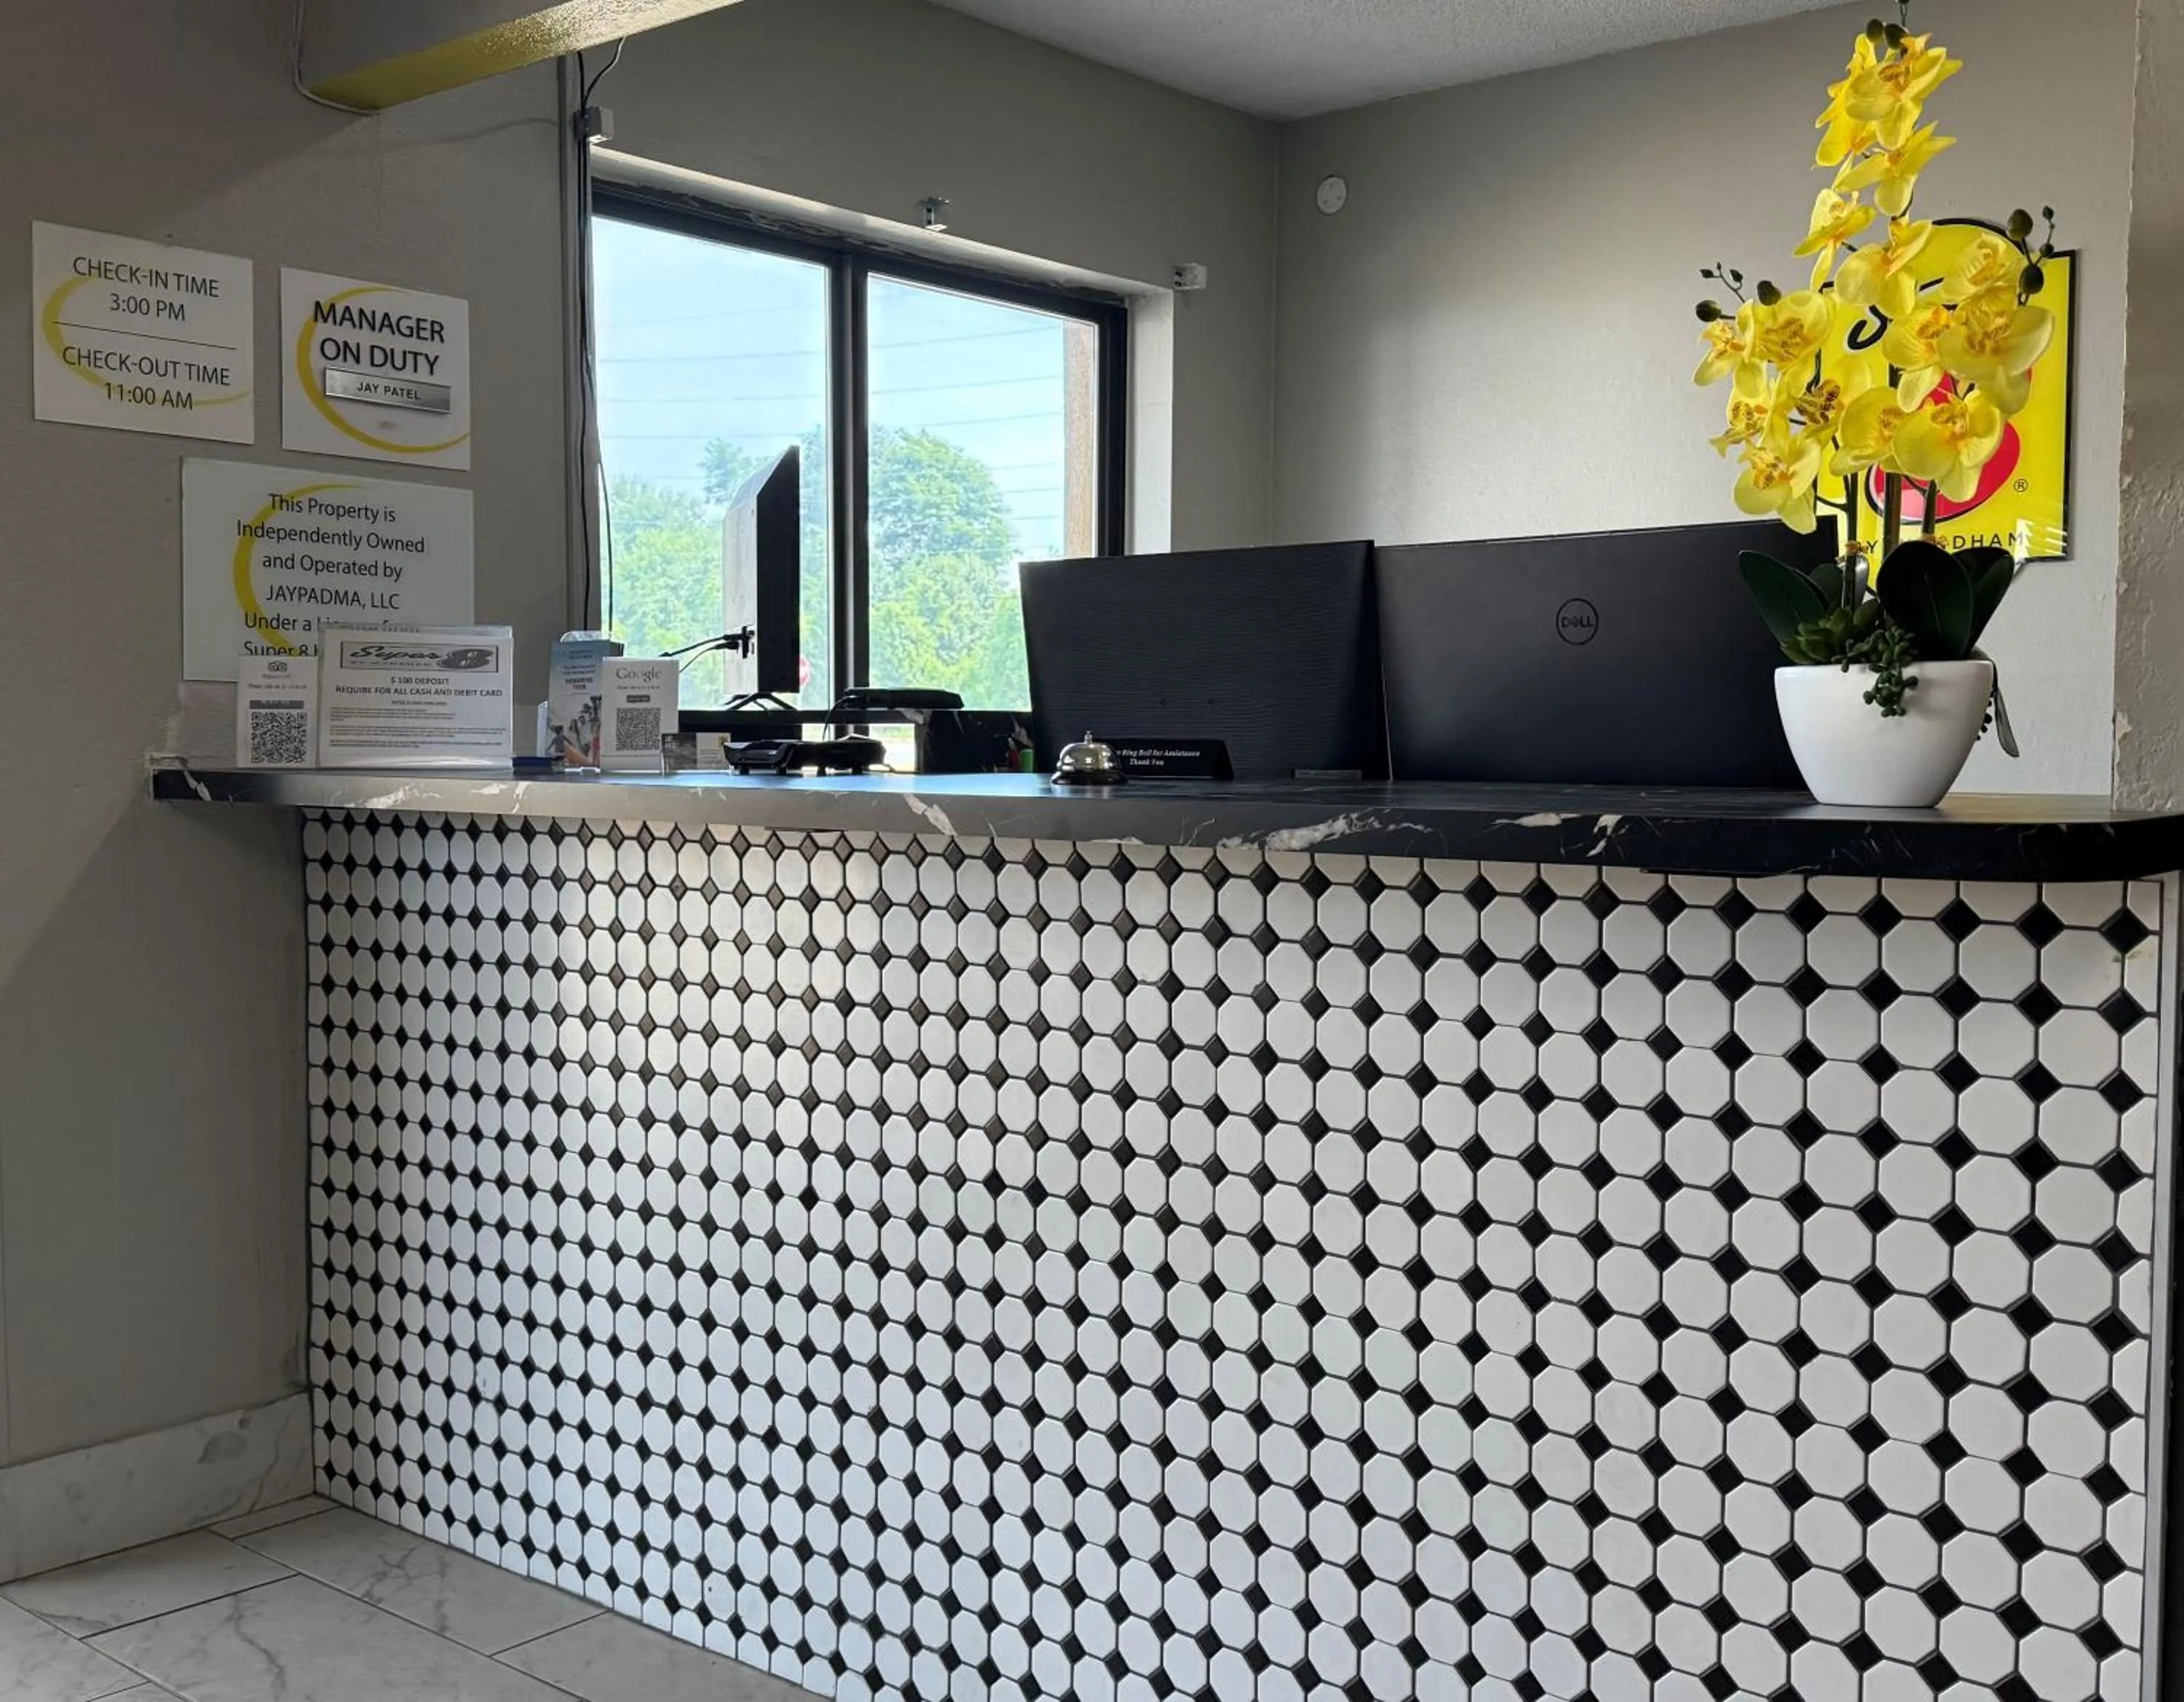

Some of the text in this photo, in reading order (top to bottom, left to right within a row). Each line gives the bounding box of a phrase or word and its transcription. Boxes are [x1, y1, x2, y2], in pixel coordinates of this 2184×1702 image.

[73, 256, 219, 297] CHECK-IN TIME
[109, 293, 186, 322] 3:00 PM
[313, 301, 445, 343] MANAGER
[63, 346, 231, 386] CHECK-OUT TIME
[320, 337, 440, 376] ON DUTY
[104, 381, 194, 411] 11:00 AM
[356, 381, 421, 401] JAY PATEL
[269, 494, 396, 524] This Property is
[237, 519, 425, 553] Independently Owned
[262, 553, 403, 582] and Operated by
[266, 585, 400, 610] JAYPADMA, LLC
[245, 612, 298, 631] Under
[302, 619, 312, 631] a
[1562, 616, 1596, 628] DELL
[414, 677, 449, 686] DEPOSIT
[616, 667, 662, 684] Google
[374, 687, 391, 695] FOR
[394, 687, 408, 695] ALL
[410, 688, 432, 696] CASH
[433, 688, 452, 697] AND
[454, 689, 478, 697] DEBIT
[480, 689, 503, 697] CARD
